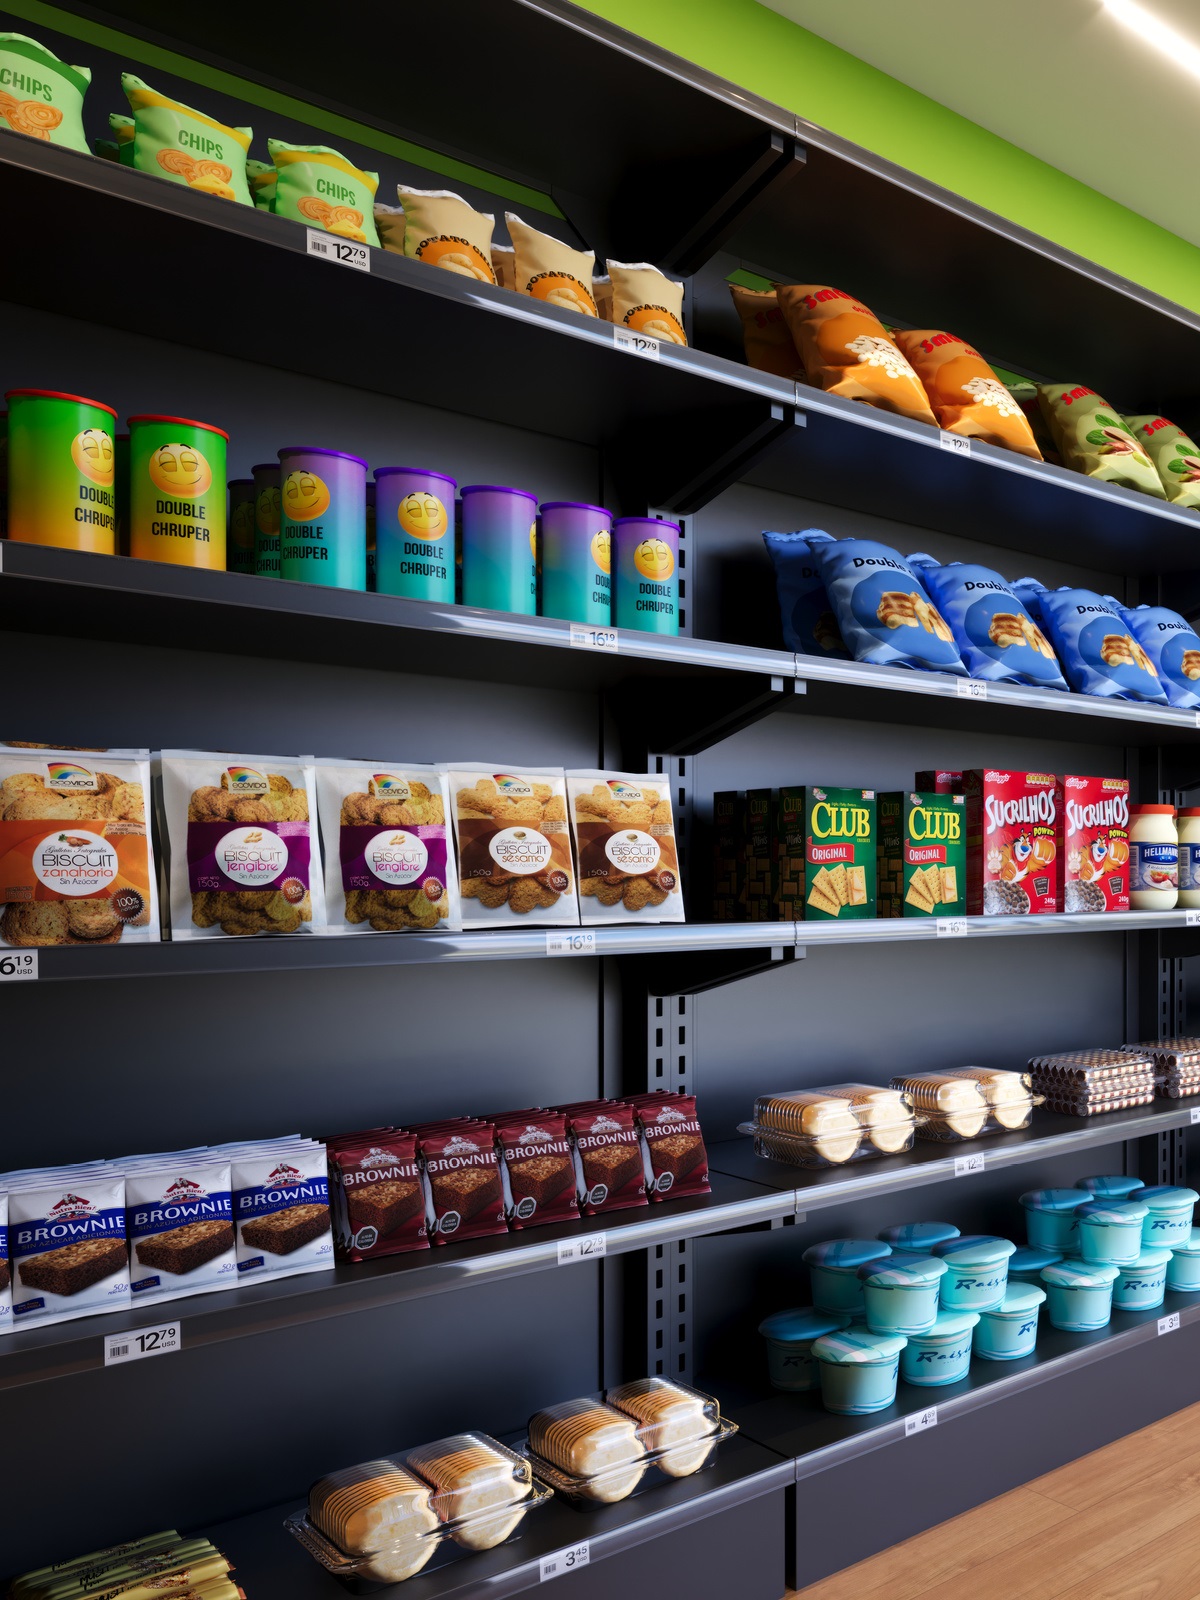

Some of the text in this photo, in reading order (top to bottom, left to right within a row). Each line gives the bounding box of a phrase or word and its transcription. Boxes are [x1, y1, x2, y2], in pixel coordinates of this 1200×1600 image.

[0, 68, 52, 102] CHIPS
[178, 129, 223, 160] CHIPS
[316, 178, 356, 206] CHIPS
[415, 234, 470, 257] POTATO
[526, 270, 575, 292] POTATO
[623, 304, 668, 324] POTATO
[156, 500, 206, 520] DOUBLE
[152, 522, 211, 543] CHRUPER
[286, 526, 324, 540] DOUBLE
[258, 540, 280, 552] DOUB
[283, 546, 328, 561] CHRUPER
[404, 542, 444, 560] DOUBLE
[256, 559, 280, 572] CHRU
[400, 561, 447, 580] CHRUPER
[596, 574, 611, 590] DOUB
[639, 583, 671, 598] DOUBLE
[636, 600, 674, 615] CHRUPER
[986, 788, 1056, 835] SUCRILHOS
[1066, 794, 1129, 836] SUCRILHOS
[811, 802, 871, 839] CLUB
[908, 806, 961, 840] CLUB
[224, 850, 282, 862] BISCUIT
[372, 852, 423, 863] BISCUIT
[496, 845, 548, 855] BISCUIT
[612, 846, 658, 856] BISCUIT
[812, 848, 848, 861] ORIGINAL
[909, 848, 940, 861] ORIGINAL
[42, 854, 114, 867] BISCUIT
[227, 861, 279, 872] jengibre
[42, 866, 114, 878] zanahoria
[117, 896, 139, 907] 100%
[645, 1121, 700, 1138] BROWNIE
[578, 1130, 638, 1149] BROWNIE
[504, 1141, 570, 1161] BROWNIE
[427, 1153, 497, 1173] BROWNIE
[342, 1164, 419, 1186] BROWNIE
[240, 1184, 329, 1209] BROWNIE
[290, 1196, 327, 1205] ADICIONADA
[134, 1199, 232, 1226] BROWNIE
[188, 1211, 231, 1222] ADICIONADA
[18, 1216, 126, 1244] BROWNIE
[76, 1228, 125, 1240] ADICIONADA
[162, 1340, 176, 1348] USD
